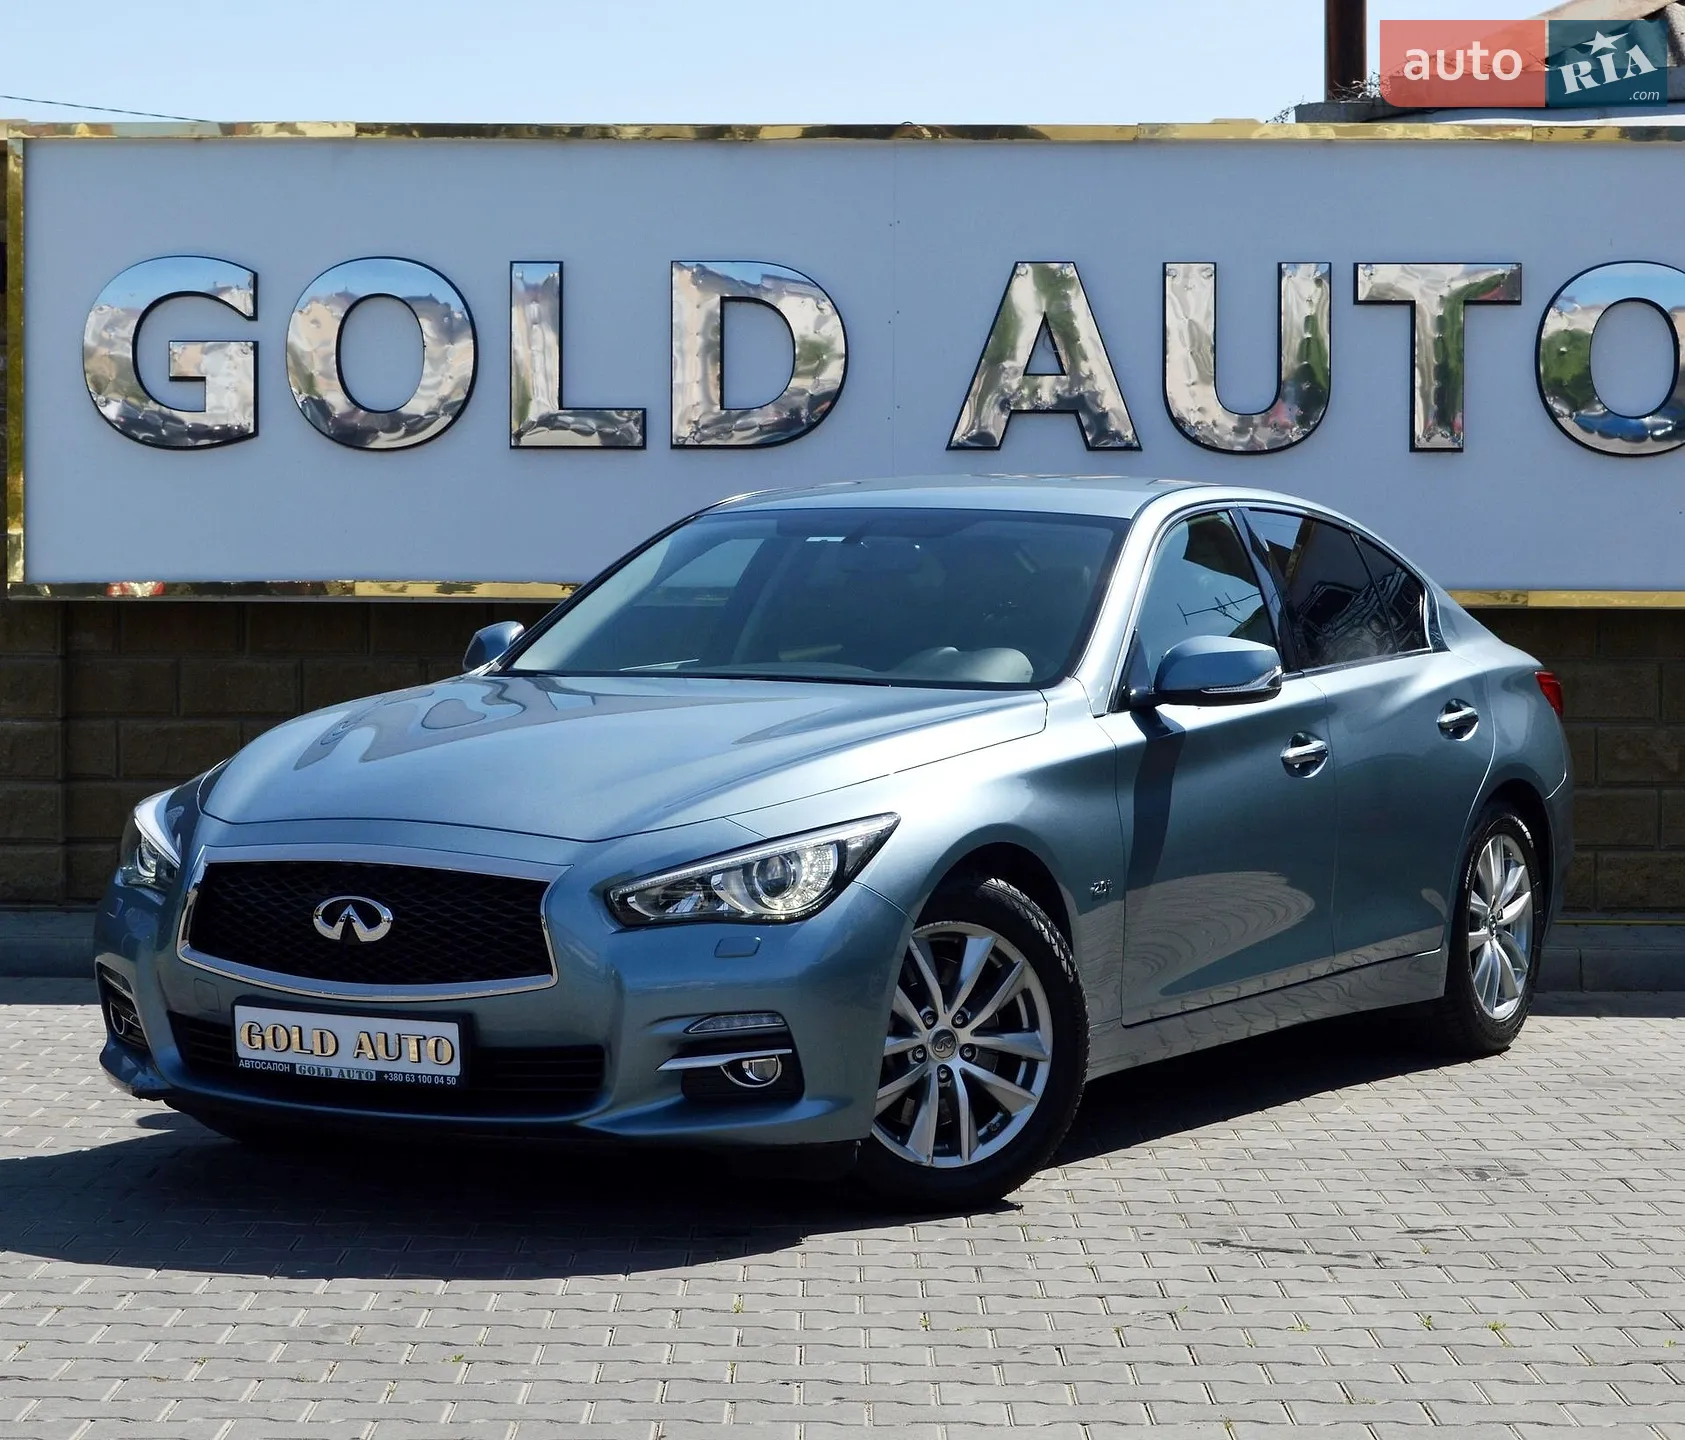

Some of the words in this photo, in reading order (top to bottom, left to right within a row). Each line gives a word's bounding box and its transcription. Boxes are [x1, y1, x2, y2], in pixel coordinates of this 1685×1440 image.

[82, 255, 850, 450] GOLD
[946, 259, 1685, 456] AUTO
[239, 1020, 339, 1058] GOLD
[353, 1031, 454, 1066] AUTO
[238, 1060, 290, 1073] АВТОСАЛОН
[297, 1065, 333, 1078] GOLD
[337, 1068, 374, 1080] AUTO
[383, 1073, 403, 1083] +380
[405, 1074, 416, 1083] 63
[418, 1075, 432, 1084] 100
[434, 1075, 445, 1085] 04
[446, 1076, 457, 1086] 50
